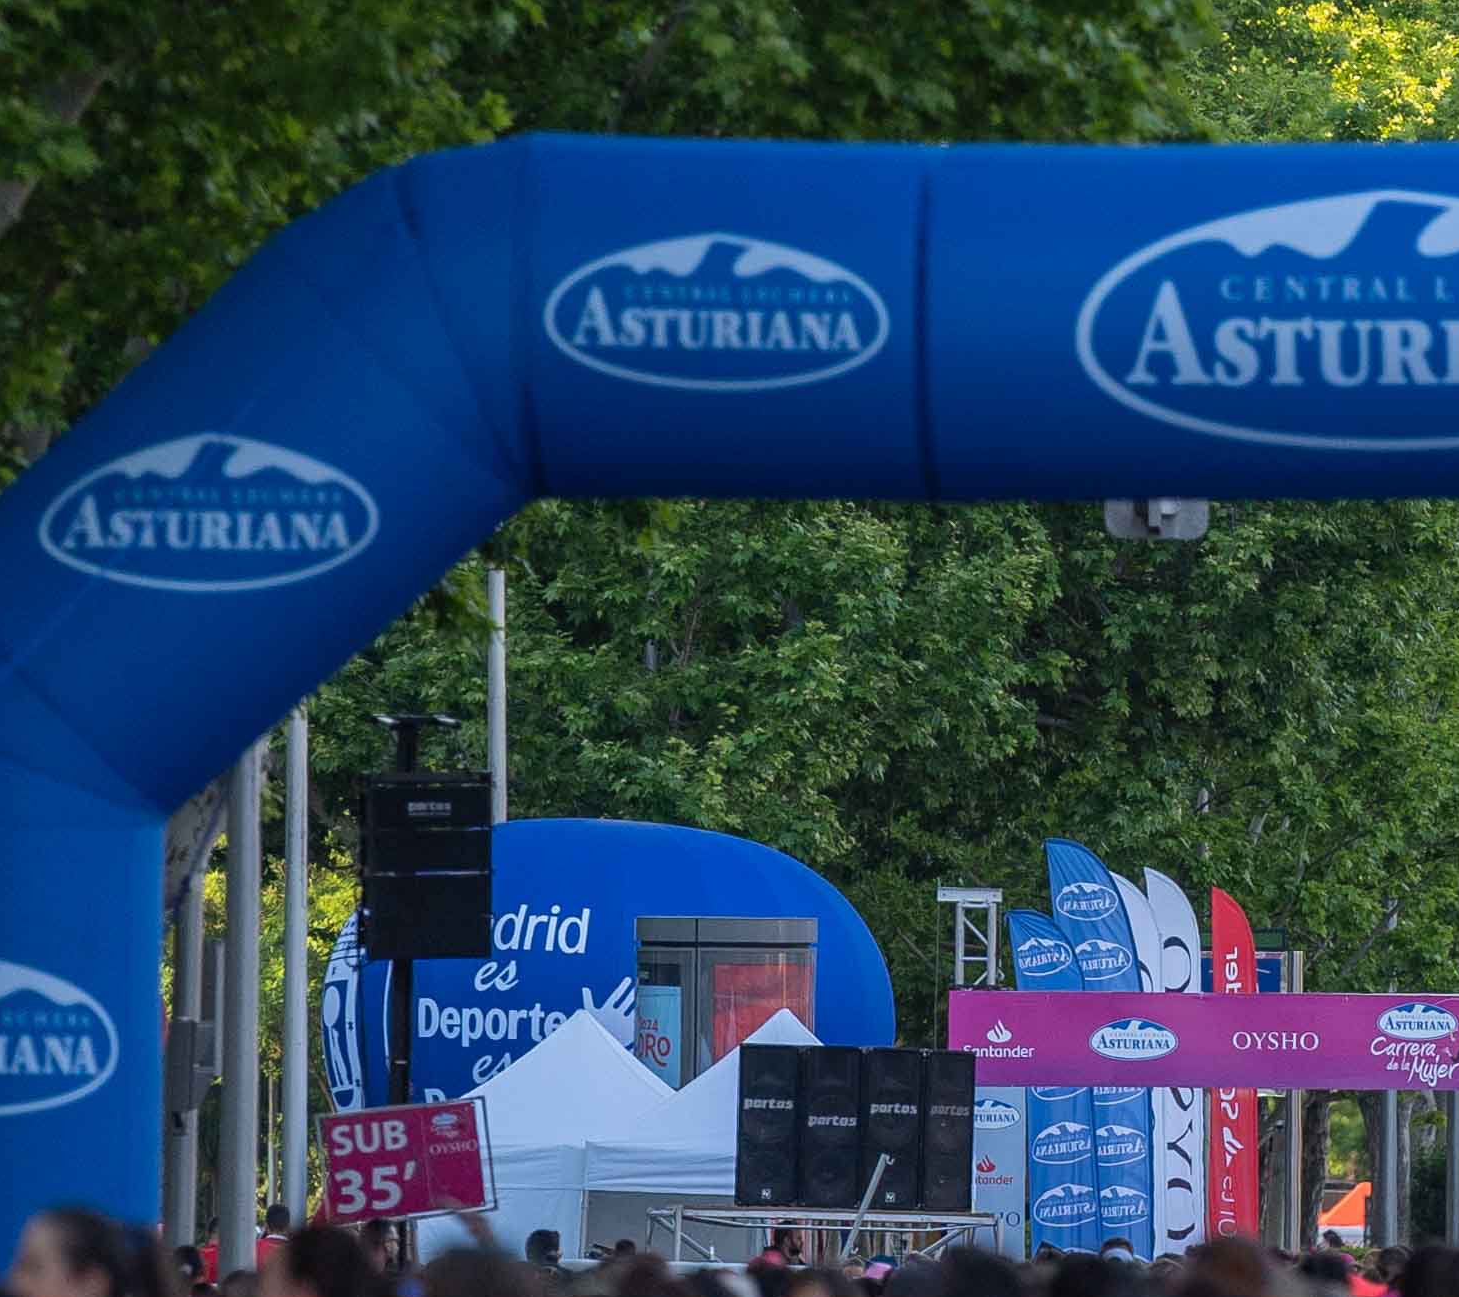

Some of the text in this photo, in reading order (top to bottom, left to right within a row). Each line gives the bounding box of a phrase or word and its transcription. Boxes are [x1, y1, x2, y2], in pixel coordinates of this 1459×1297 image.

[1220, 275, 1411, 301] CENTRAL
[573, 285, 862, 351] ASTURIANA
[61, 494, 350, 551] ASTURIANA
[491, 904, 591, 954] drid
[473, 960, 520, 991] es
[1385, 1014, 1452, 1031] ASTURIANA
[963, 1045, 1036, 1058] Santander
[1096, 1033, 1171, 1050] ASTURIANA
[1231, 1030, 1320, 1052] OYSHO
[1370, 1037, 1437, 1057] Carrera
[1386, 1057, 1400, 1072] de
[330, 1118, 408, 1157] SUB
[975, 1175, 1014, 1185] tander
